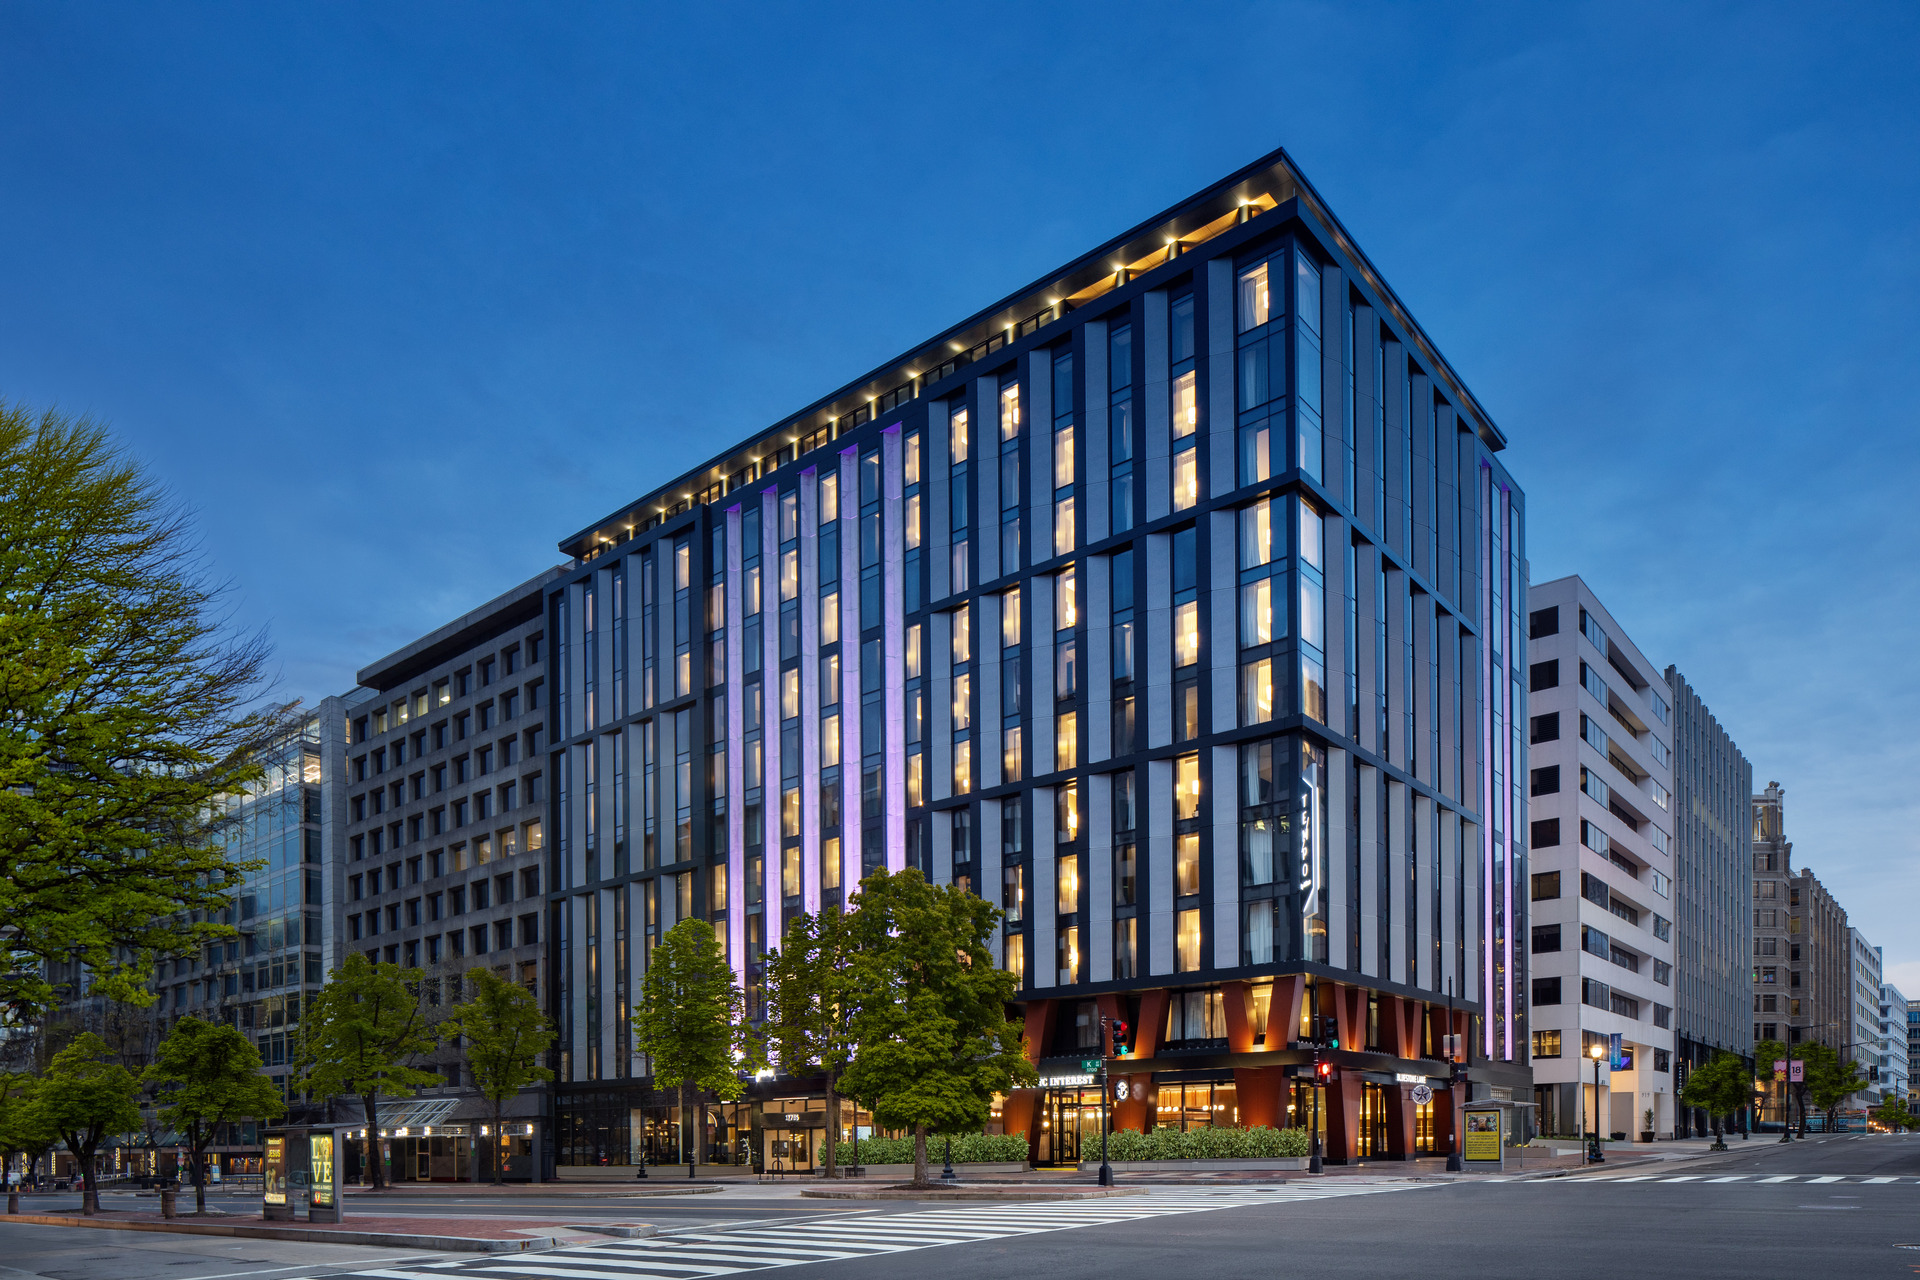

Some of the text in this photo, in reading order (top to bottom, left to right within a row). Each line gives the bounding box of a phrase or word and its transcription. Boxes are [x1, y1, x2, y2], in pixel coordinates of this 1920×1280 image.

[1301, 794, 1310, 877] TEMPO
[1791, 1066, 1801, 1074] 18
[1050, 1075, 1094, 1086] INTEREST
[1396, 1073, 1427, 1084] BLUESTONE LANE
[268, 1149, 281, 1157] JESUS
[312, 1161, 332, 1183] VE
